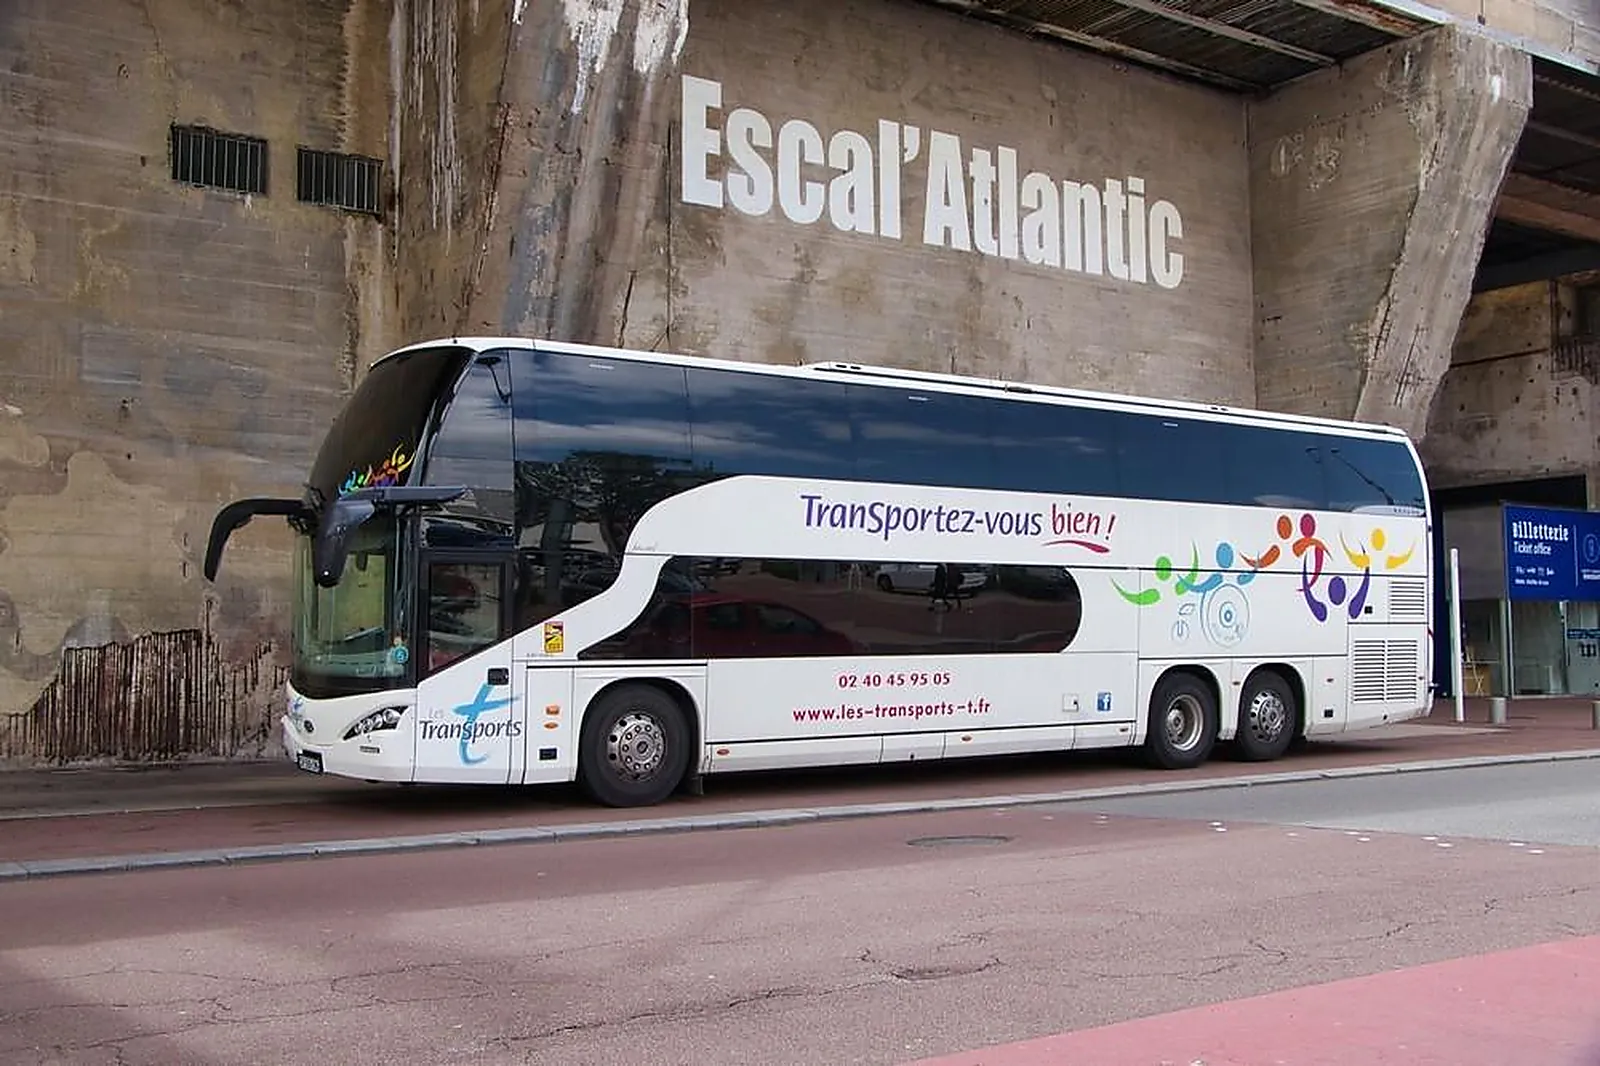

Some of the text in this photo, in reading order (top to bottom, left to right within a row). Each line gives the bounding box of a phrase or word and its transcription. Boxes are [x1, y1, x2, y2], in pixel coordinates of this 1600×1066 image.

[1051, 503, 1101, 536] bien
[838, 673, 951, 688] 02 40 45 95 05
[419, 719, 522, 744] Transports
